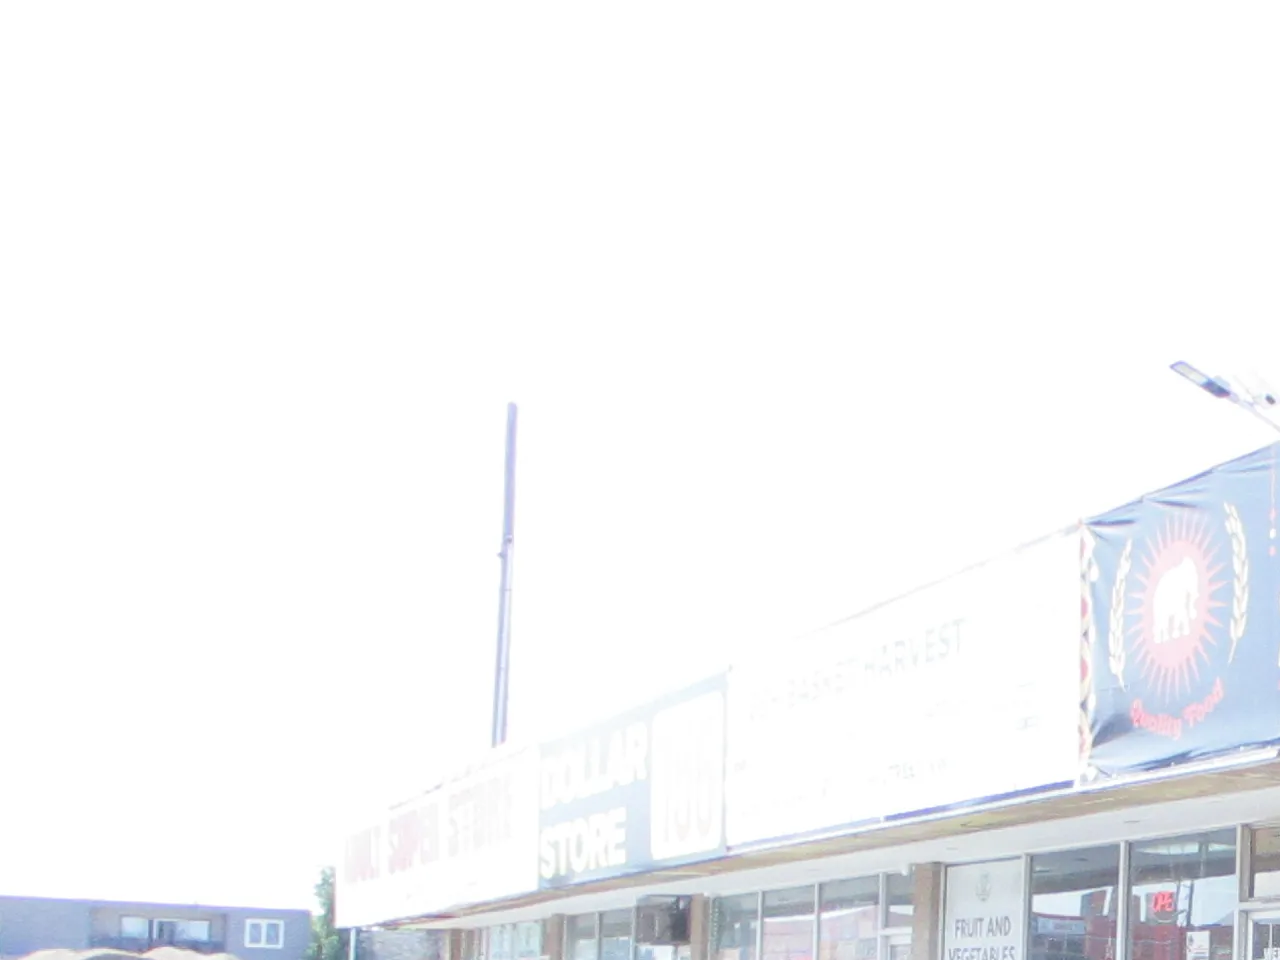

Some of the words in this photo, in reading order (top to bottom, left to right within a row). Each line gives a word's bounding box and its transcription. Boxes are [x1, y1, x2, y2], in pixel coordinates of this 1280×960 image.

[864, 616, 968, 683] HARVEST
[541, 721, 648, 810] DOLLAR
[540, 807, 627, 879] STORE
[954, 917, 984, 940] FRUIT
[986, 915, 1012, 938] AND
